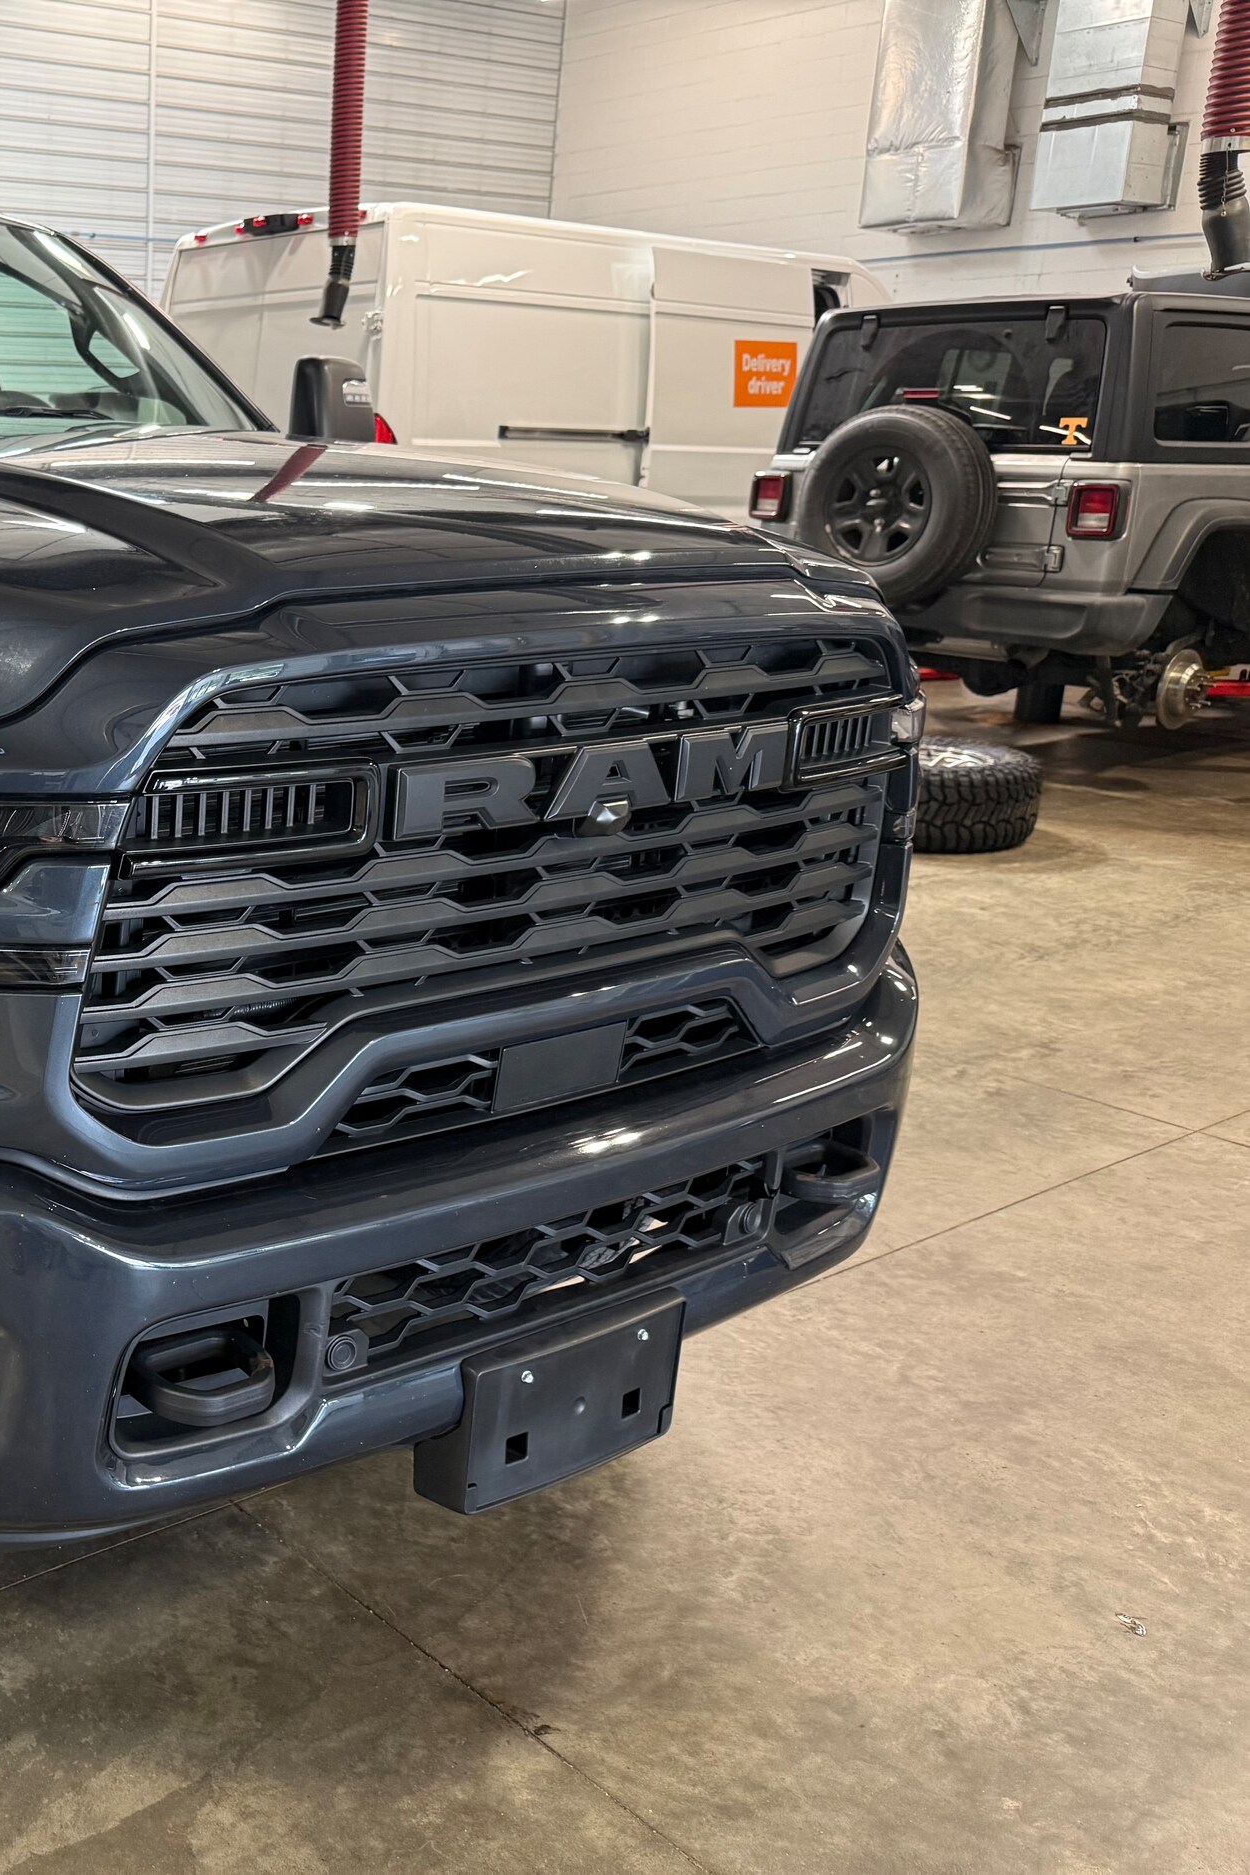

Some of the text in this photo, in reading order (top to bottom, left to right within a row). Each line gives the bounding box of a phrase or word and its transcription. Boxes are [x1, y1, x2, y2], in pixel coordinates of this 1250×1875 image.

[741, 353, 791, 376] Delivery
[747, 377, 785, 394] driver
[1059, 416, 1089, 445] T
[393, 720, 789, 841] RAM
